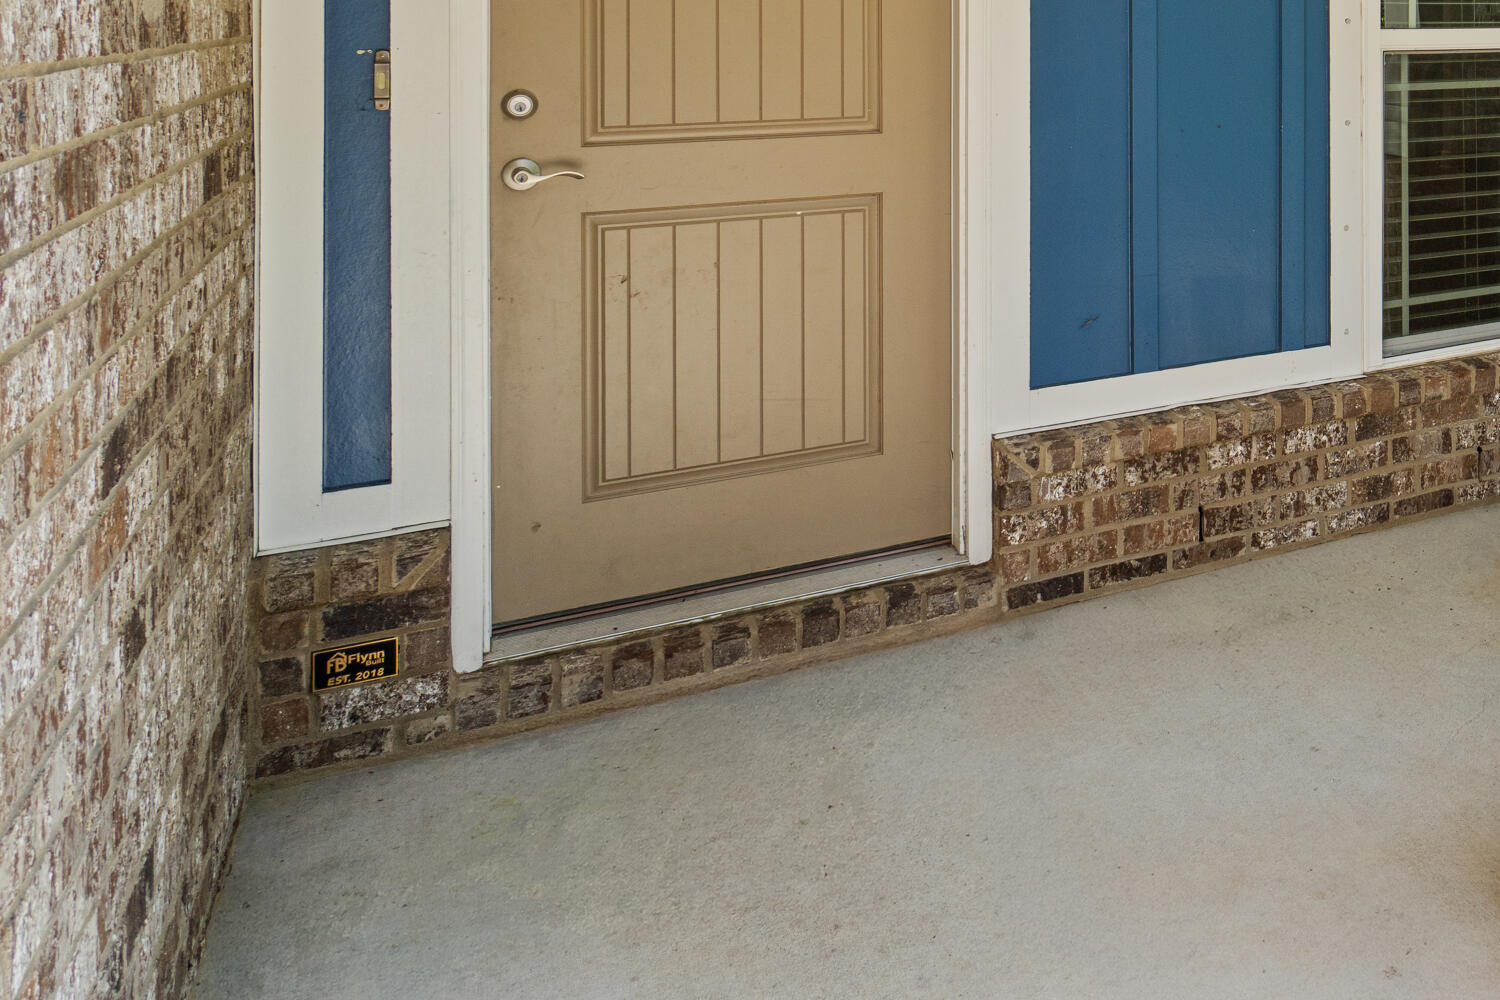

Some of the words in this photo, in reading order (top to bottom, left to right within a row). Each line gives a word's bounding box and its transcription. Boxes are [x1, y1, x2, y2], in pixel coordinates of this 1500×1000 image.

[348, 650, 385, 664] Flynn
[327, 674, 351, 686] EST.
[355, 668, 385, 681] 2018
